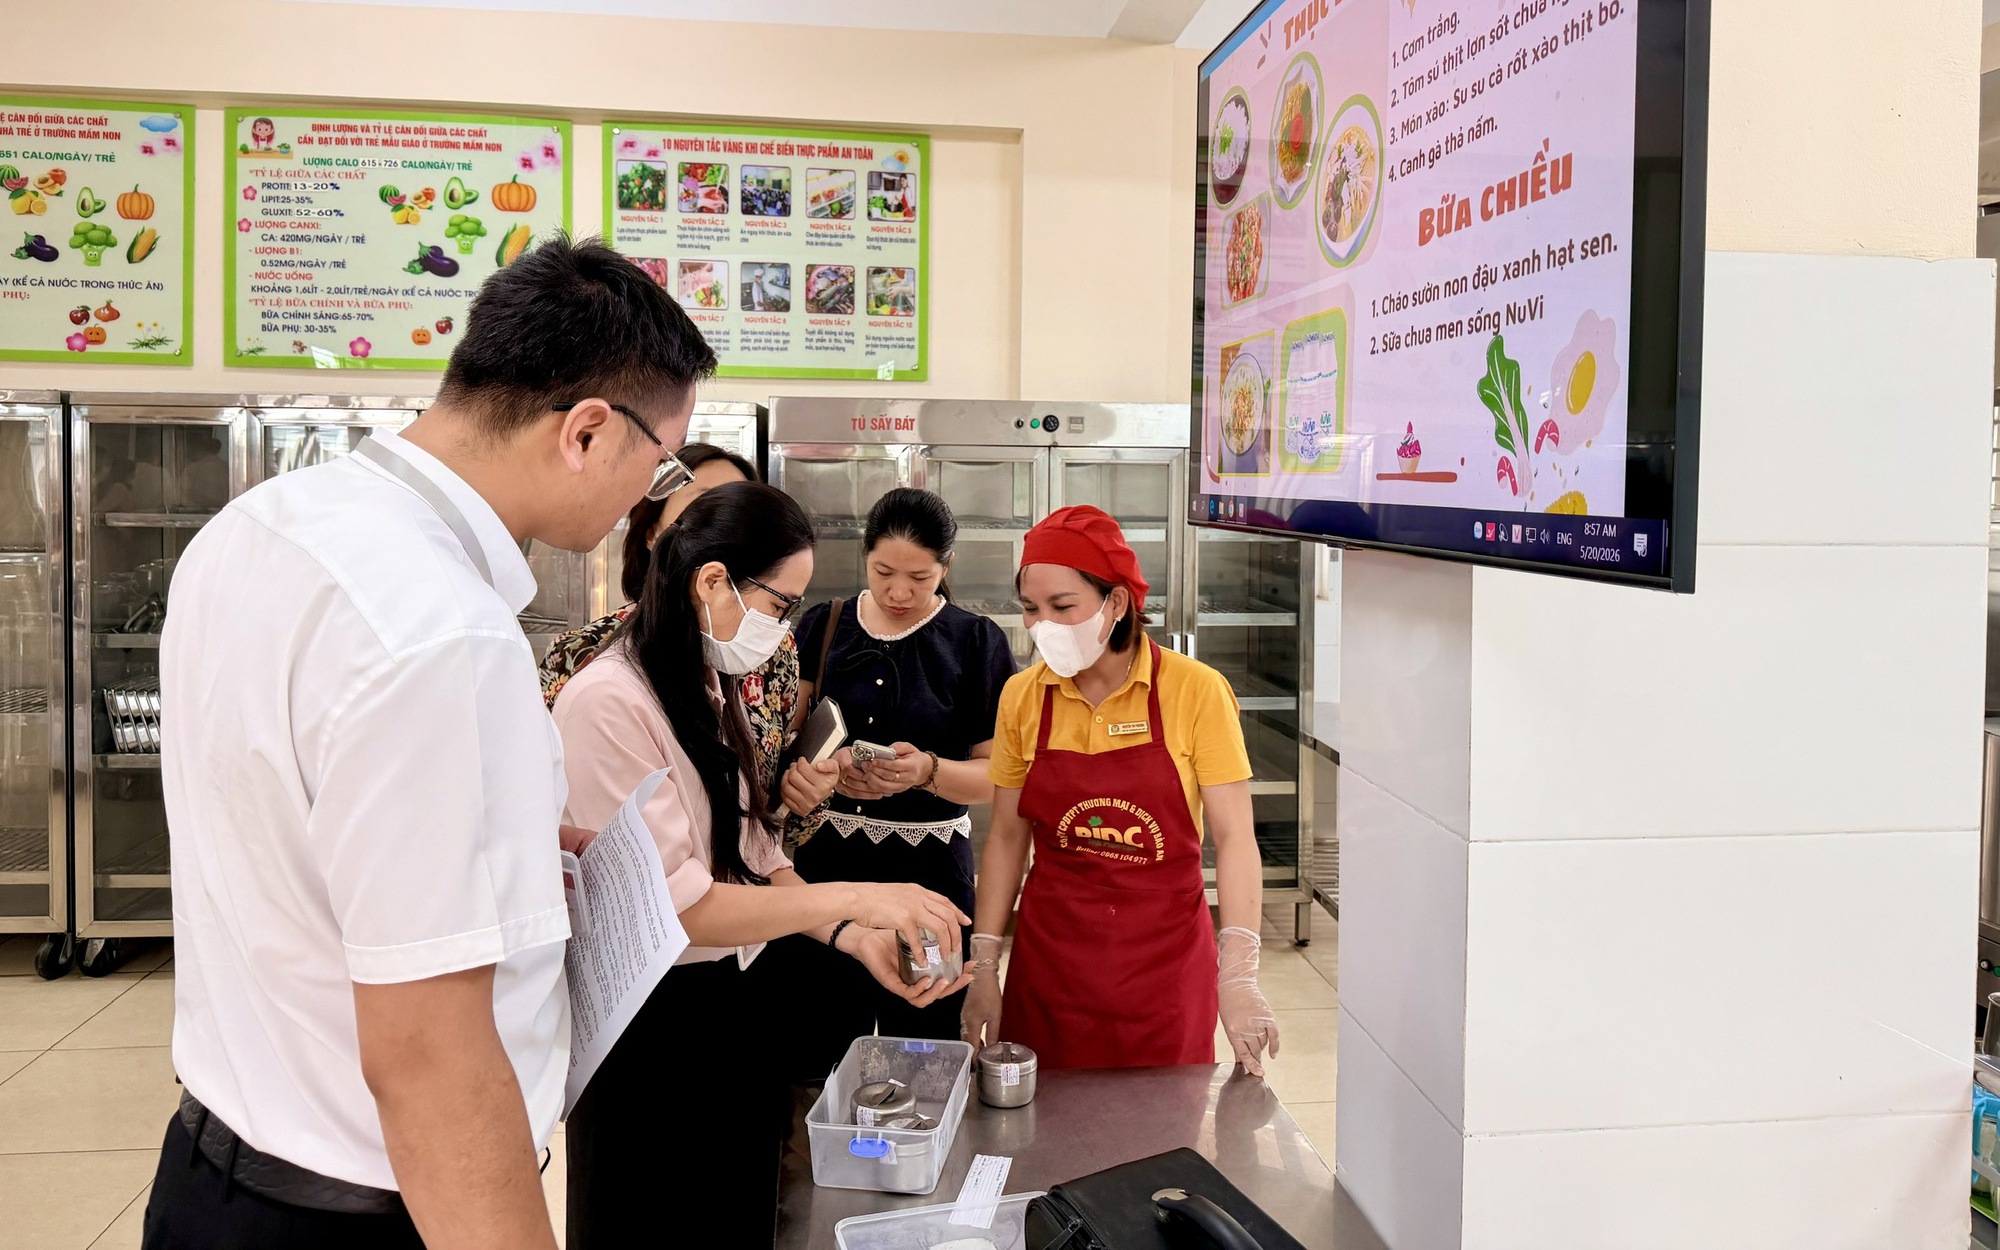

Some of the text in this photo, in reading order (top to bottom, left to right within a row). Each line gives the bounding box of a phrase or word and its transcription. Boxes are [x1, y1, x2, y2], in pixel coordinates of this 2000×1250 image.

[1392, 12, 1460, 68] 1. Cơm trắng.
[1391, 88, 1399, 108] 2.
[1402, 75, 1424, 100] Tôm
[1427, 60, 1439, 85] sú
[1443, 45, 1463, 75] thịt
[1467, 35, 1485, 61] lợn
[1489, 14, 1509, 45] sốt
[1390, 127, 1398, 145] 3.
[1401, 114, 1422, 139] Món
[1425, 99, 1449, 126] xào:
[1453, 87, 1468, 109] Su
[1471, 77, 1485, 99] su
[1488, 63, 1503, 88] cà
[1507, 48, 1527, 79] rốt
[1532, 35, 1558, 65] xào
[1563, 9, 1593, 46] thịt
[45, 113, 65, 125] GIỮA
[67, 114, 84, 125] CÁC
[87, 114, 108, 126] CHẤT
[16, 125, 31, 136] TRẺ
[42, 127, 76, 139] TRƯỜNG
[103, 131, 121, 140] NON
[485, 143, 502, 152] NON
[663, 139, 672, 149] 10
[673, 137, 704, 152] NGUYÊN
[706, 136, 720, 152] TẮC
[723, 139, 743, 153] VÀNG
[745, 142, 758, 154] KHI
[841, 147, 851, 159] AN
[854, 146, 873, 160] TOÀN
[1388, 115, 1498, 182] 4. Canh gà thả nấm.
[95, 151, 116, 162] TRẺ
[303, 157, 333, 168] LƯỢNG
[335, 158, 359, 166] CALO
[457, 160, 473, 171] TRẺ
[285, 168, 311, 179] GIỮA
[314, 169, 335, 179] CÁC
[338, 168, 367, 180] CHẤT
[1418, 137, 1572, 246] BỮA CHIỀU
[254, 220, 321, 230] LƯỢNG CANXI:
[351, 233, 366, 244] TRẺ
[254, 246, 287, 256] LƯỢNG
[254, 270, 313, 280] NƯỚC UỐNG
[1372, 233, 1617, 318] 1. Cháo sườn non đậu xanh hạt sen.
[30, 276, 45, 287] CẢ
[48, 277, 77, 288] NƯỚC
[81, 280, 115, 289] TRONG
[118, 279, 143, 290] THỨC
[418, 286, 432, 297] CẢ
[286, 297, 307, 307] BỮA
[310, 298, 344, 308] CHÍNH
[261, 310, 279, 319] BỮA
[282, 311, 311, 320] CHÍNH
[261, 322, 279, 332] BỮA
[1370, 295, 1544, 355] 2. Sữa chua men sống NuVi
[851, 414, 915, 431] TỦ SẤY BÁT
[1584, 523, 1617, 537] 8:57 AM
[1557, 532, 1572, 545] ENG
[1580, 545, 1621, 562] 5/20/2026
[1129, 804, 1136, 814] &
